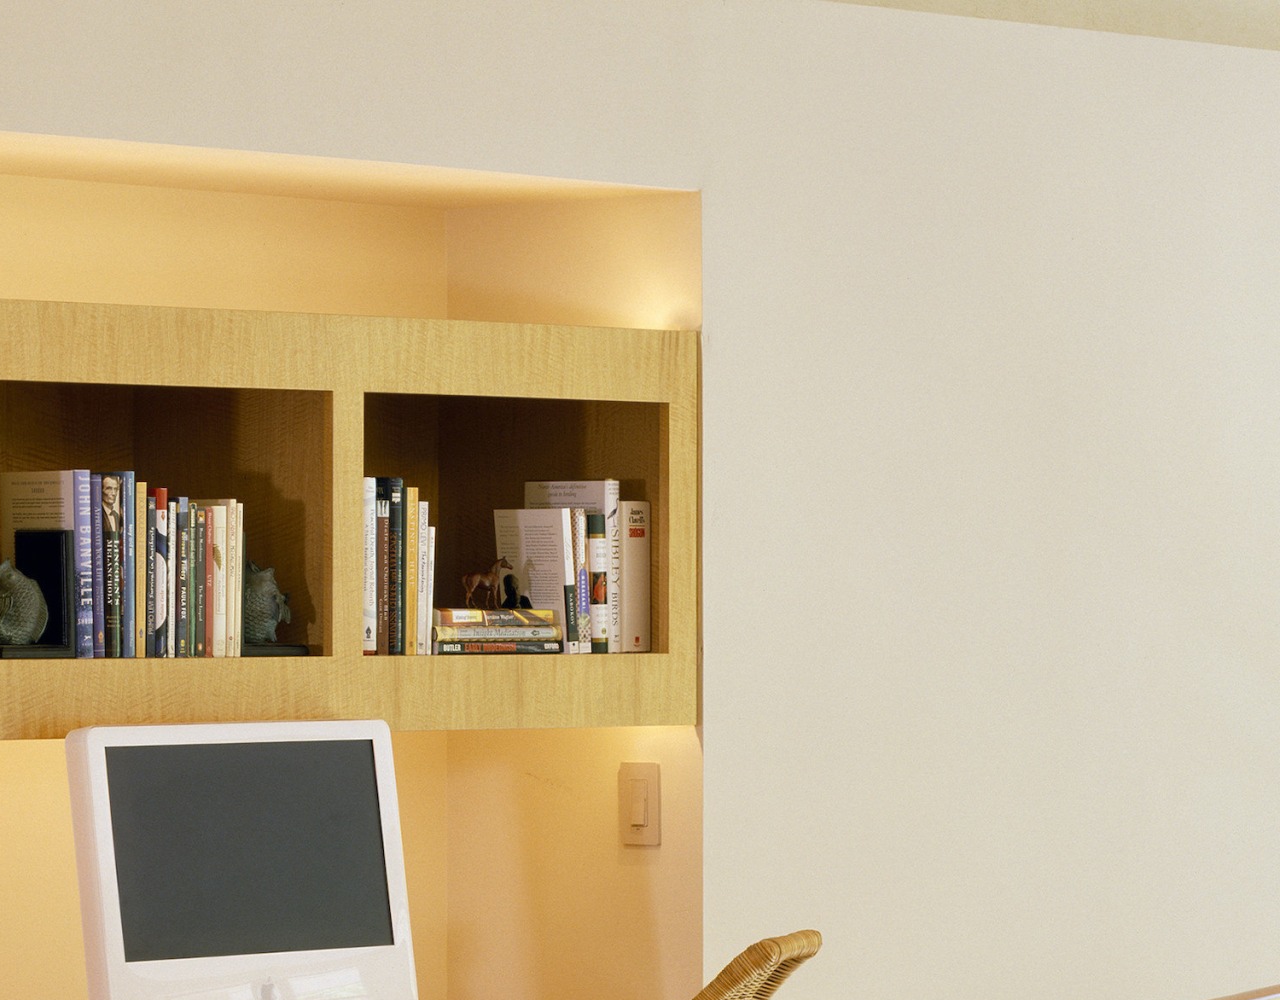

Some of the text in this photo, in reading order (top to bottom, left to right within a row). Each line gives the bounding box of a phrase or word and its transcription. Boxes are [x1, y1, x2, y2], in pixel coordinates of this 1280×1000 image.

[78, 475, 91, 516] JOHN
[94, 506, 103, 546] APPRECIATE
[80, 525, 93, 607] BANVILLE
[94, 547, 103, 566] YOUR
[611, 528, 619, 626] SIBLEY BIRDS
[443, 644, 461, 652] BUTLER
